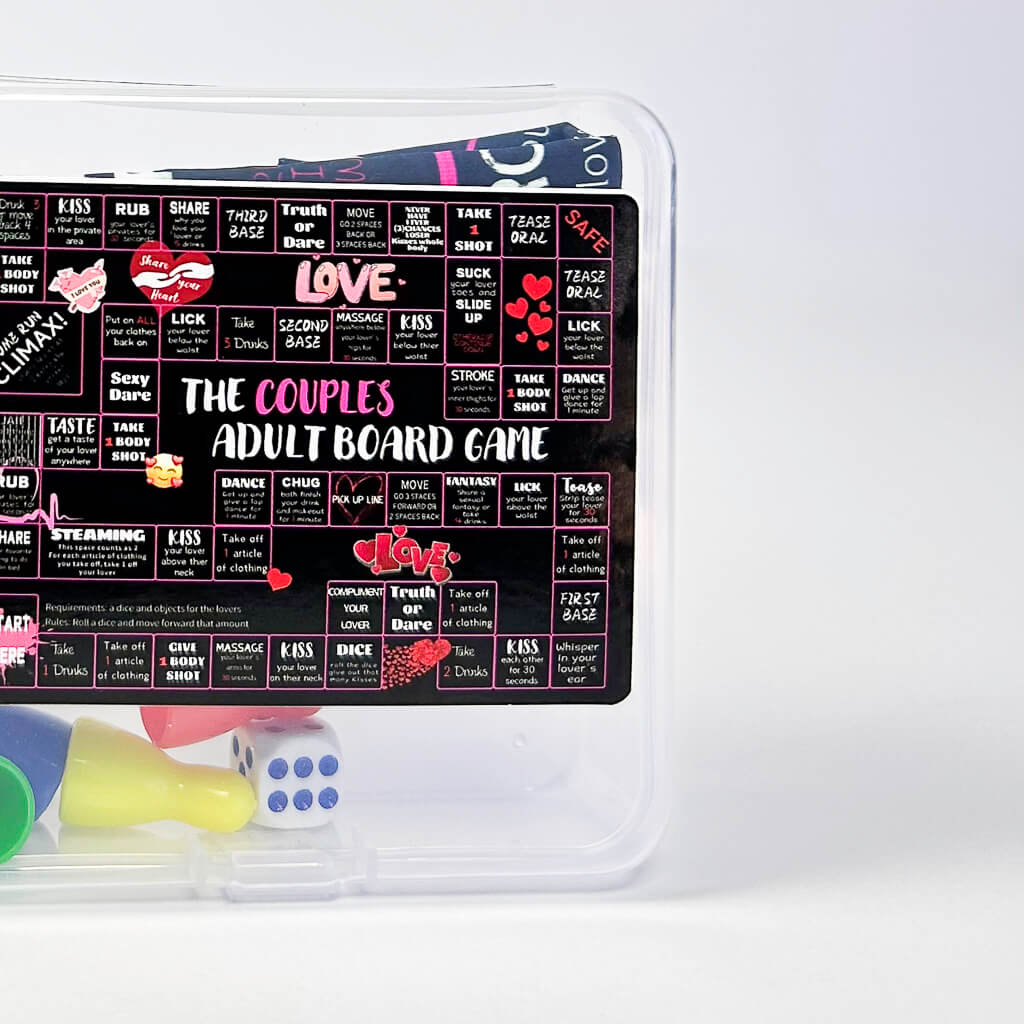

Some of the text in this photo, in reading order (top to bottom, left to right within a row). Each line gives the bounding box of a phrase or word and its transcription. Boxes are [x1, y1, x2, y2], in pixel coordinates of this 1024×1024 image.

[58, 198, 91, 214] KISS
[115, 203, 150, 215] RUB
[169, 201, 210, 215] SHARE
[281, 204, 328, 216] Truth
[226, 210, 268, 222] THIRD
[347, 208, 375, 218] MOVE
[456, 208, 492, 219] TAKE
[54, 216, 73, 224] your
[508, 216, 551, 228] TEASE
[294, 222, 314, 232] or
[470, 225, 479, 235] 1
[565, 210, 610, 254] SAFE
[229, 226, 264, 239] BASE
[511, 231, 548, 244] ORAL
[284, 237, 325, 249] Dare
[455, 241, 493, 251] SHOT
[1, 255, 33, 264] TAKE
[4, 270, 39, 279] BODY
[456, 268, 491, 278] SUCK
[564, 270, 605, 283] TEASE
[295, 261, 397, 303] LOVE
[0, 284, 34, 294] SHOT
[566, 286, 602, 298] ORAL
[151, 289, 180, 303] Heart
[456, 299, 491, 310] SLIDE
[17, 311, 42, 335] RUN
[105, 316, 120, 324] Put
[171, 313, 205, 324] LICK
[230, 317, 255, 328] Take
[336, 313, 384, 323] MASSAGE
[400, 314, 433, 330] KISS
[465, 313, 483, 323] UP
[279, 320, 328, 332] SECOND
[567, 321, 601, 331] LICK
[114, 338, 134, 346] back
[285, 335, 321, 348] BASE
[110, 372, 150, 387] Sexy
[451, 370, 495, 381] STROKE
[514, 374, 544, 383] TAKE
[563, 374, 605, 383] DANCE
[109, 389, 151, 401] Dare
[181, 377, 395, 417] THE COUPLES
[506, 388, 551, 397] 1 BODY
[514, 402, 547, 412] SHOT
[47, 417, 96, 434] TASTE
[113, 423, 144, 432] TAKE
[105, 438, 151, 447] 1 BODY
[212, 422, 550, 462] ADULT BOARD GAME
[112, 452, 146, 461] SHOT
[51, 458, 91, 466] anywhere
[221, 478, 266, 488] DANCE
[282, 478, 320, 488] CHUG
[401, 480, 429, 490] MOVE
[446, 477, 497, 486] FANTASY
[514, 482, 541, 492] LICK
[332, 495, 350, 503] PICK
[367, 496, 384, 504] LINE
[51, 528, 145, 542] STEAMING
[169, 529, 201, 546] KISS
[222, 534, 264, 543] Take off
[562, 536, 601, 544] Take off
[233, 549, 262, 558] article
[376, 533, 450, 575] LOVE
[573, 550, 600, 559] article
[216, 564, 268, 575] of clothing
[556, 565, 605, 575] of clothing
[390, 586, 436, 598] Truth
[449, 589, 489, 598] Take off
[560, 593, 600, 605] FIRST
[136, 604, 152, 612] and
[154, 605, 185, 614] objects
[187, 605, 198, 613] for
[200, 605, 215, 613] the
[216, 605, 242, 613] lovers
[344, 604, 368, 612] YOUR
[403, 605, 422, 615] or
[459, 604, 488, 613] article
[563, 609, 597, 621] BASE
[73, 618, 89, 626] Roll
[118, 618, 134, 627] and
[161, 619, 195, 627] forward
[197, 619, 214, 627] that
[341, 620, 370, 629] LOVER
[391, 619, 433, 631] Dare
[443, 619, 492, 629] of clothing
[52, 643, 74, 655] Take
[104, 641, 146, 650] Take off
[168, 643, 197, 652] GIVE
[216, 643, 264, 653] MASSAGE
[281, 642, 313, 658] KISS
[337, 644, 373, 656] DICE
[507, 639, 539, 655] KISS
[452, 646, 475, 656] Take
[115, 656, 144, 665] article
[159, 657, 205, 666] 1 BODY
[277, 664, 294, 672] your
[510, 666, 535, 674] for 30
[98, 671, 149, 681] of clothing
[166, 671, 200, 680] SHOT
